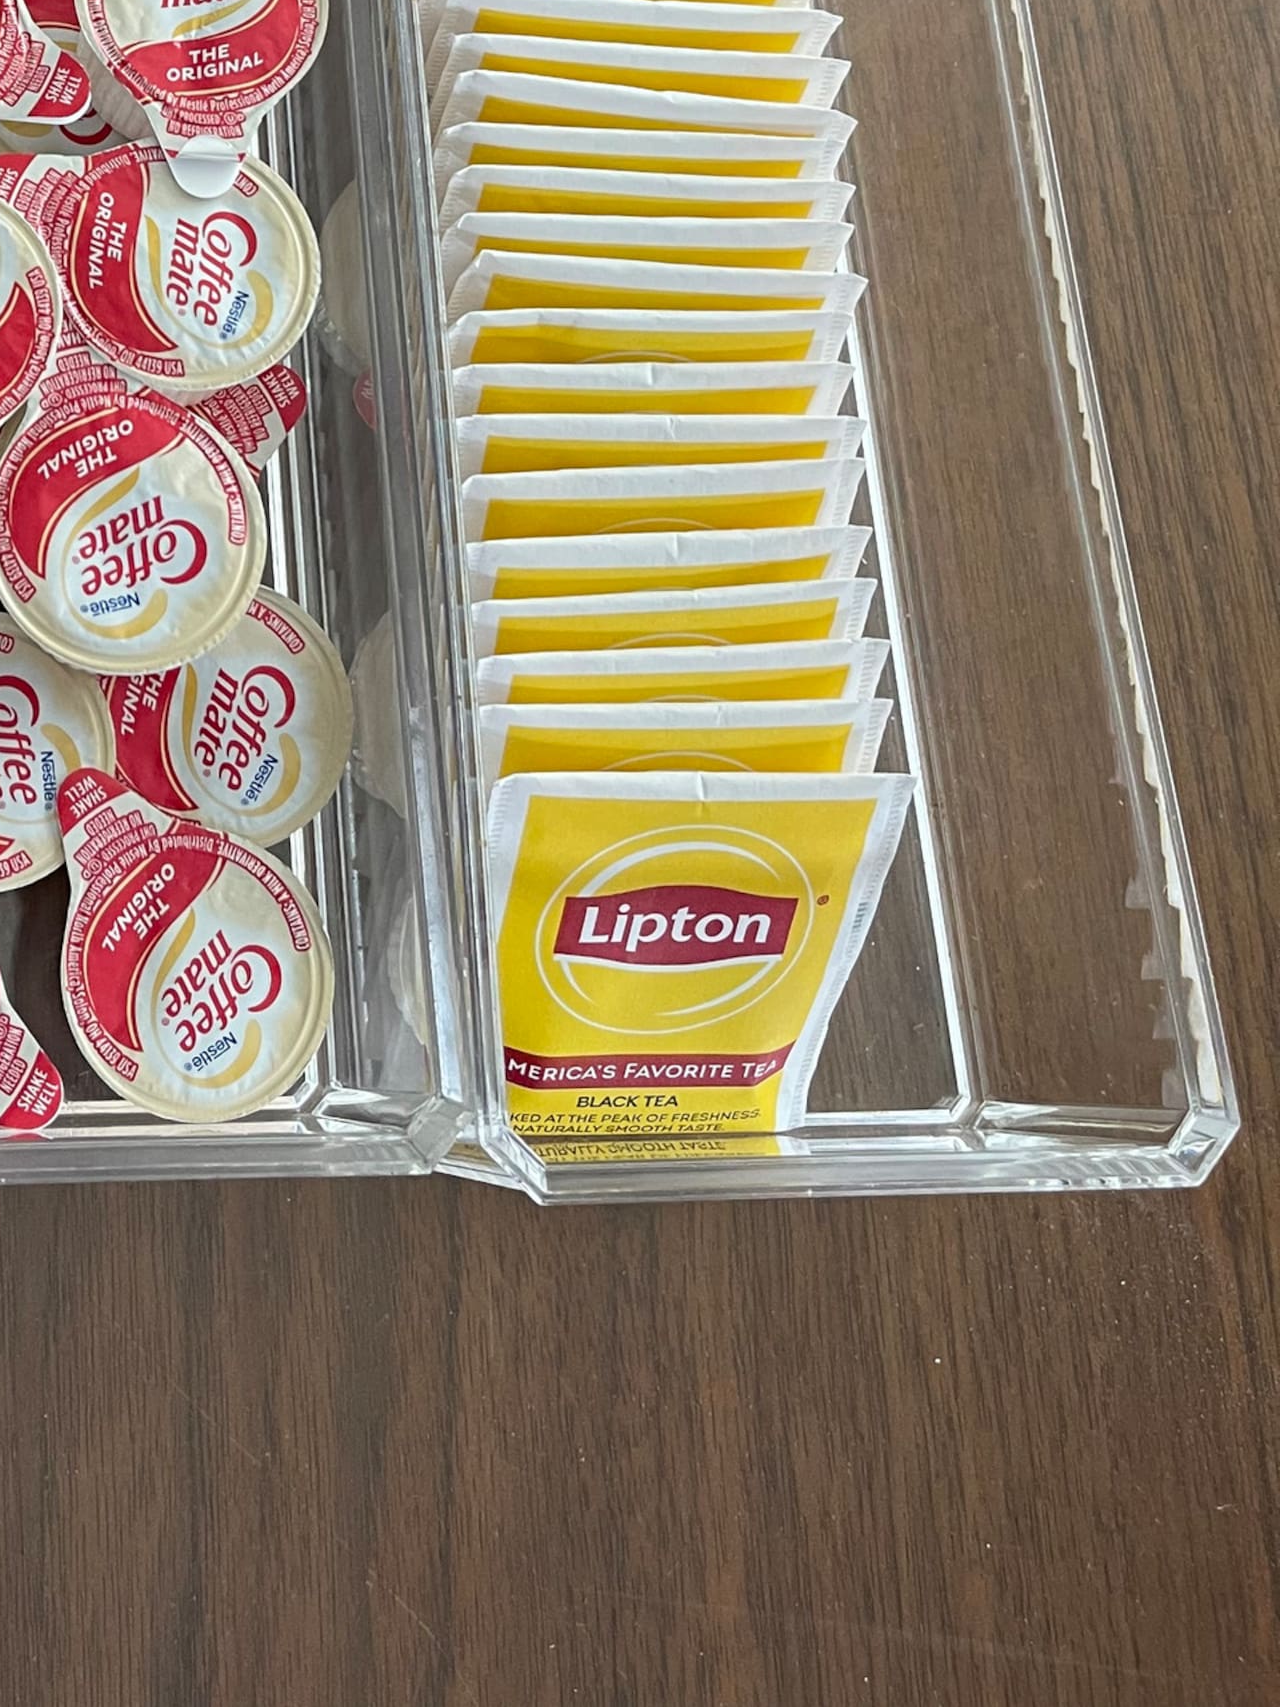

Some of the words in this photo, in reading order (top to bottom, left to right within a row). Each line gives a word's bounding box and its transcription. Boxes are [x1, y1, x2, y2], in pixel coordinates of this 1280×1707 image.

[166, 52, 263, 81] ORIGINAL
[189, 44, 229, 64] THE
[46, 67, 70, 103] SHAKE
[59, 76, 82, 105] WELL
[88, 192, 114, 289] ORIGINAL
[107, 222, 127, 261] THE
[166, 219, 199, 307] mate
[194, 211, 257, 326] Coffee
[37, 420, 134, 479] ORIGINAL
[76, 447, 118, 479] THE
[78, 496, 165, 560] mate
[81, 519, 208, 596] Coffee
[194, 668, 239, 766] mate
[219, 665, 296, 790] Coffee
[102, 863, 176, 951] ORIGINAL
[133, 898, 169, 940] THE
[579, 904, 771, 952] Lipton
[161, 929, 233, 1017] mate
[175, 945, 282, 1051] Coffee
[17, 1070, 48, 1111] SHAKE
[508, 1059, 616, 1081] MERICA'S
[32, 1084, 59, 1116] WELL
[510, 1113, 542, 1123] KED
[544, 1114, 566, 1123] AT
[568, 1114, 597, 1123] THE
[601, 1114, 641, 1123] PEAK
[646, 1113, 667, 1122] OF
[577, 1096, 639, 1108] BLACK
[644, 1096, 678, 1107] TEA
[512, 1124, 601, 1133] NATURALLY
[606, 1124, 673, 1133] SMOOTH
